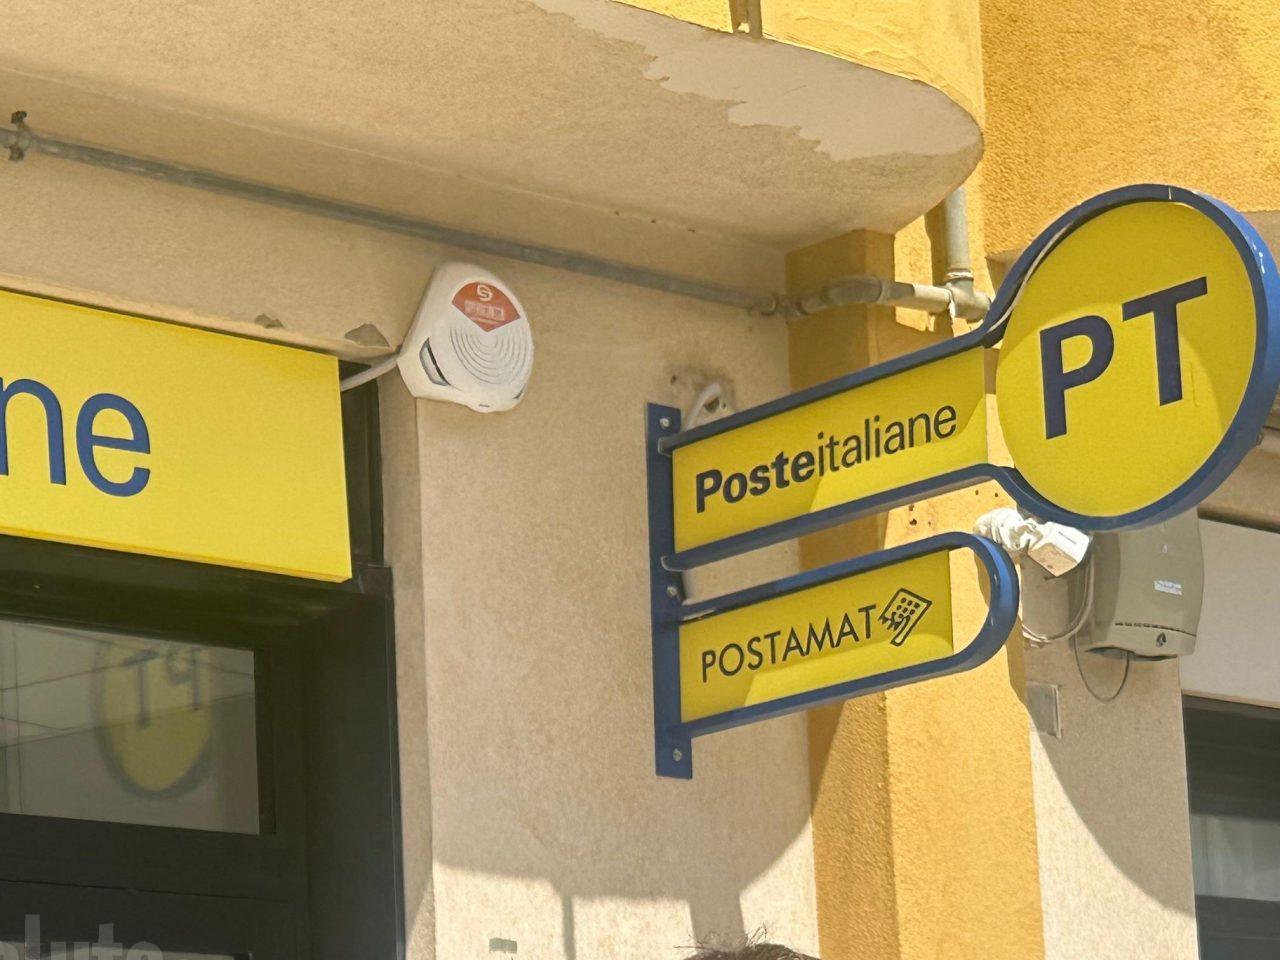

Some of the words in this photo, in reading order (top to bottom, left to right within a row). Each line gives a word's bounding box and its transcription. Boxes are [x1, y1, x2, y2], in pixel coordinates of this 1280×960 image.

[1038, 275, 1209, 441] PT
[694, 404, 958, 513] Posteitaliane
[700, 603, 878, 683] POSTAMAT
